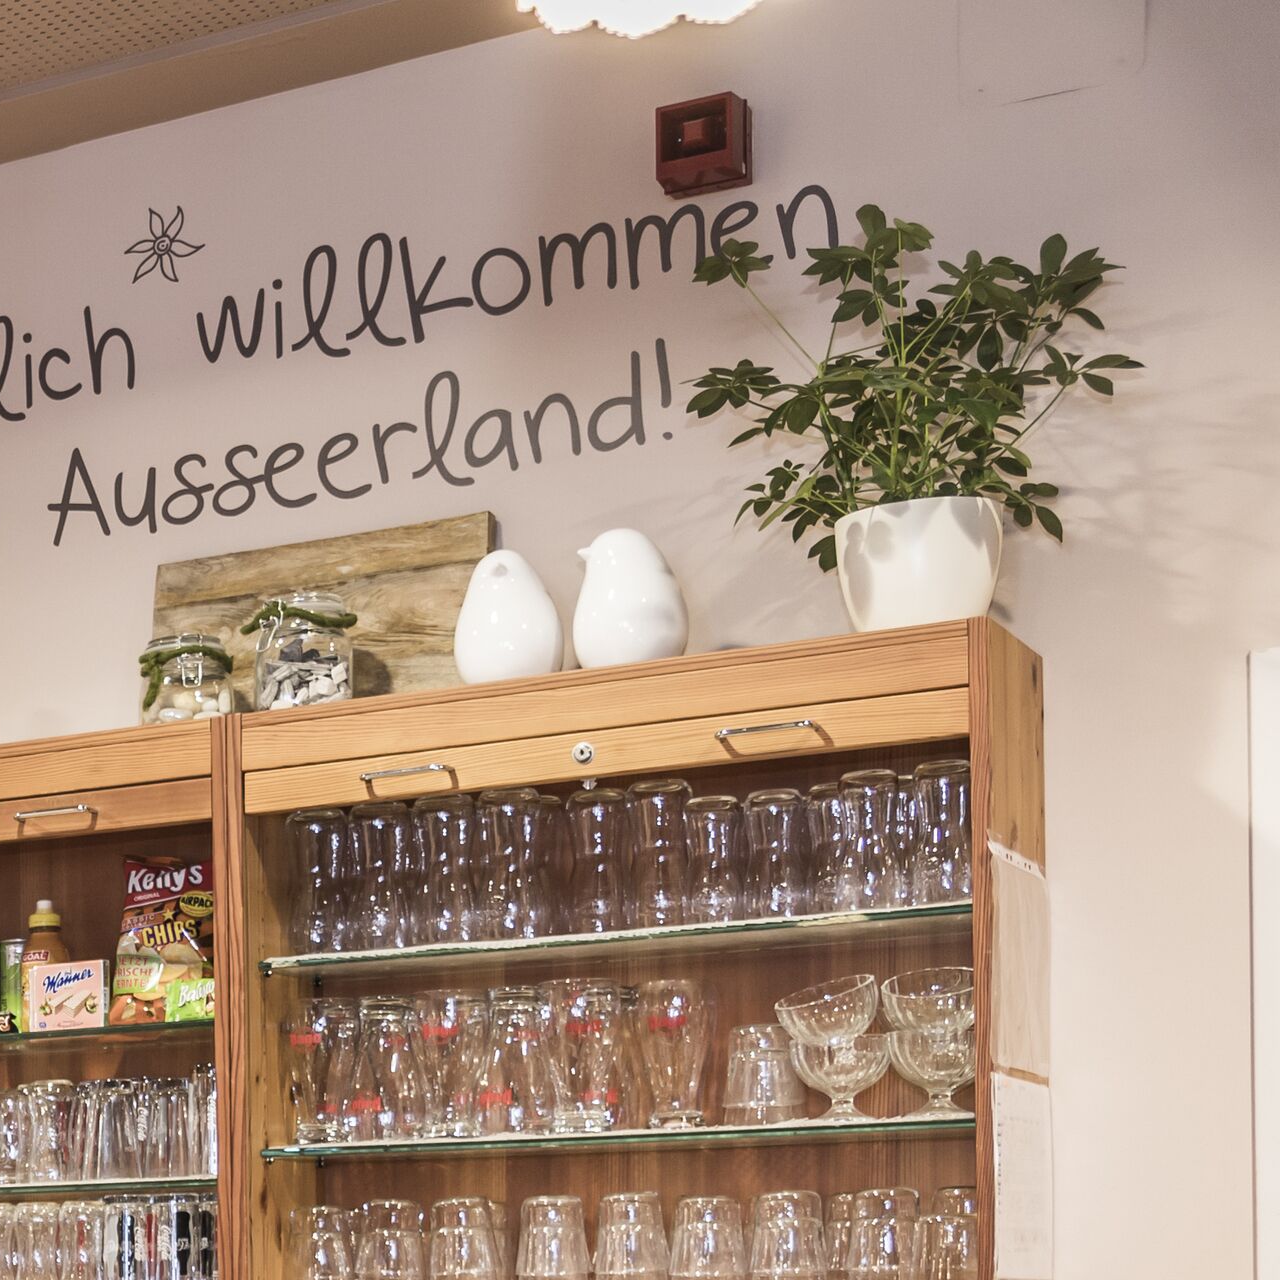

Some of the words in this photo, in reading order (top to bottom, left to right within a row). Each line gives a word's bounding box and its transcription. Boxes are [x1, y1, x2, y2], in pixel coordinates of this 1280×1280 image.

[195, 183, 838, 362] willkommen
[46, 336, 677, 548] Ausseerland!
[42, 967, 95, 994] Manner
[141, 918, 199, 948] CHIPS
